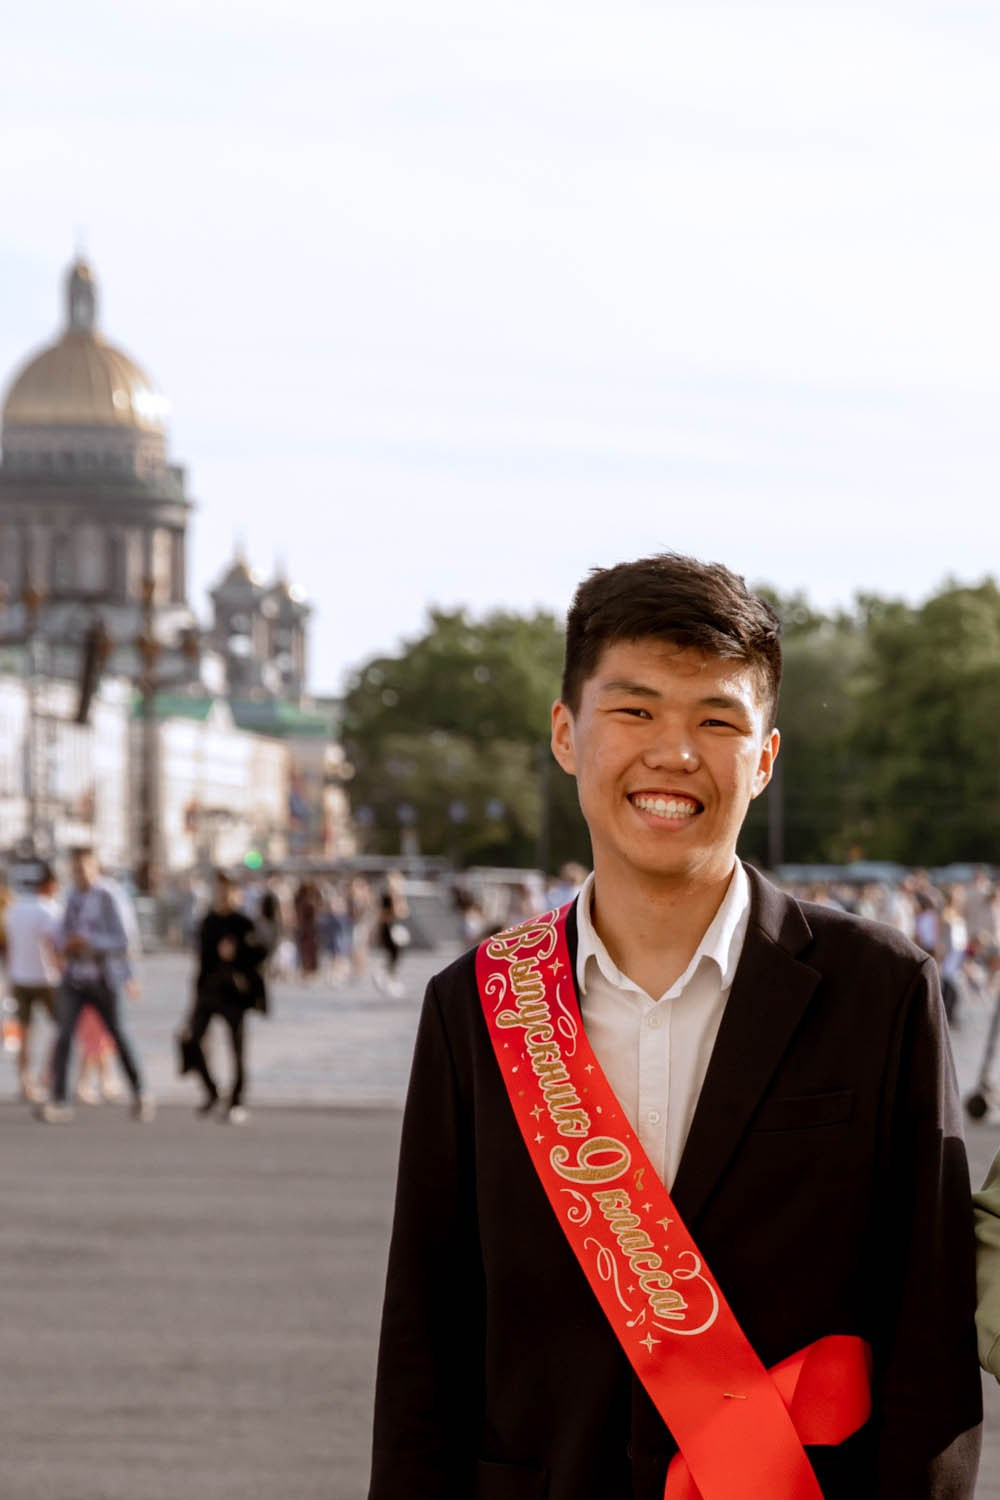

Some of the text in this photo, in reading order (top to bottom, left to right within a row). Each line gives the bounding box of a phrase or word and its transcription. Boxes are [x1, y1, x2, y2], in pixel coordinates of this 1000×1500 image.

[486, 907, 689, 1320] Выпускник 9 класса
